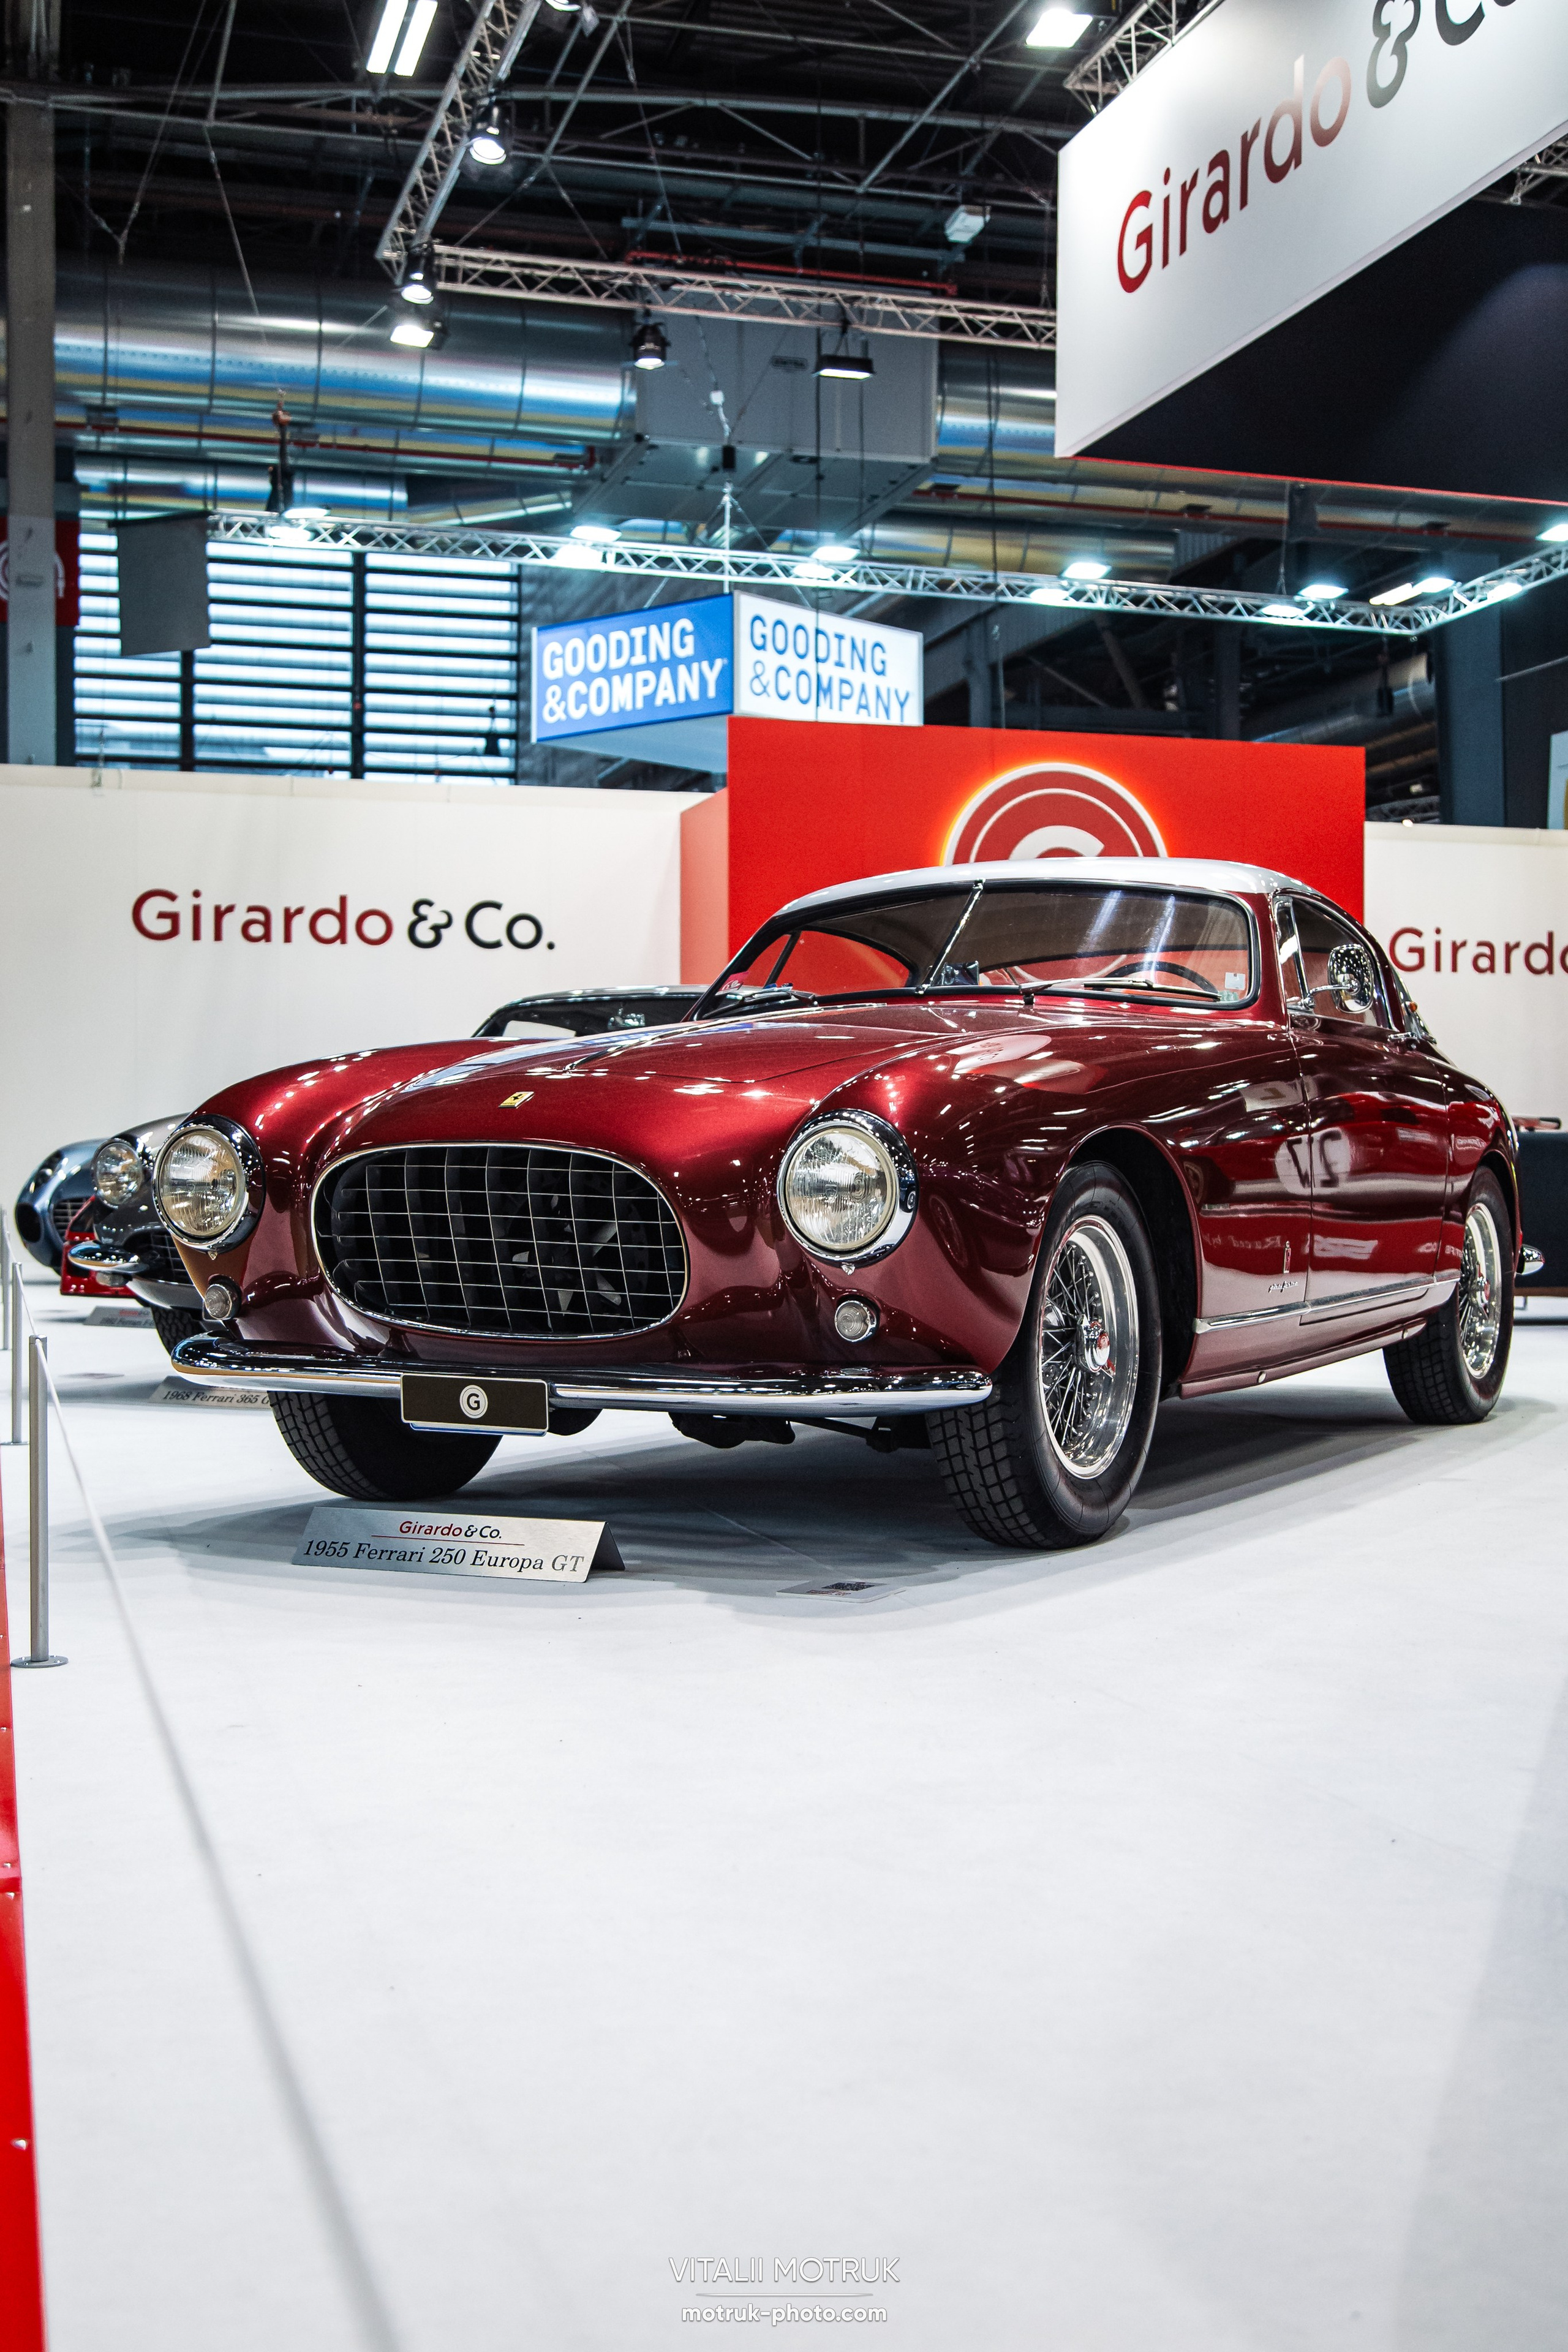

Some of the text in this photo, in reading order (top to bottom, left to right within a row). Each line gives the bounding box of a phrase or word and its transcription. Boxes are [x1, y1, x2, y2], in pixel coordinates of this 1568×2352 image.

[1117, 54, 1351, 294] Girardo
[543, 617, 695, 680] GOODING
[750, 614, 888, 677] GOODING
[132, 888, 394, 946] Girardo
[163, 1390, 190, 1400] 1968
[192, 1391, 235, 1403] Ferrari
[236, 1394, 260, 1404] 365
[466, 1393, 481, 1410] G
[399, 1520, 462, 1537] Girardo
[304, 1540, 585, 1573] 1955 Ferrari 250 Europa GT
